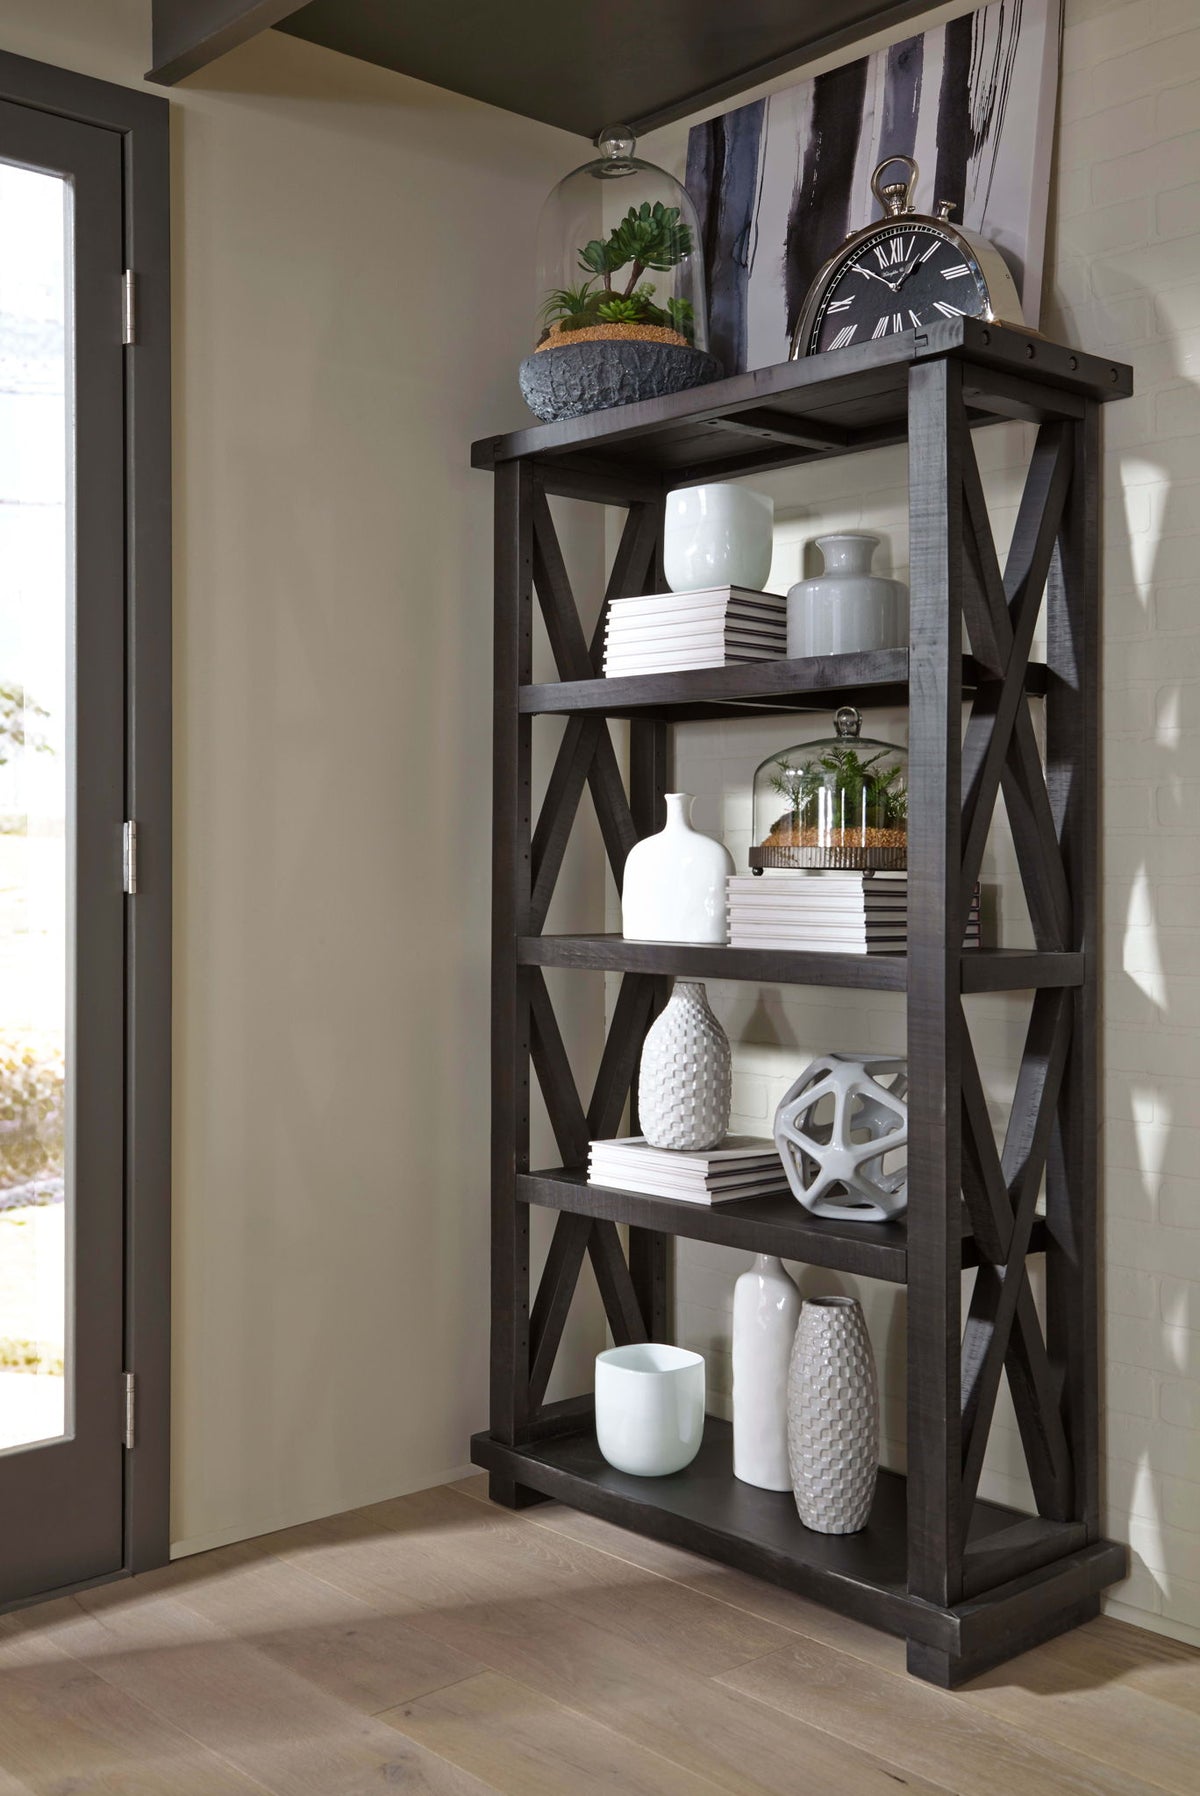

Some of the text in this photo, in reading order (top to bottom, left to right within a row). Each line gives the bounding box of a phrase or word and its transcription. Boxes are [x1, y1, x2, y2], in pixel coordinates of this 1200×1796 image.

[873, 245, 890, 269] XI
[890, 236, 904, 265] XII
[919, 240, 942, 263] II
[940, 263, 970, 280] III
[826, 295, 856, 315] IX
